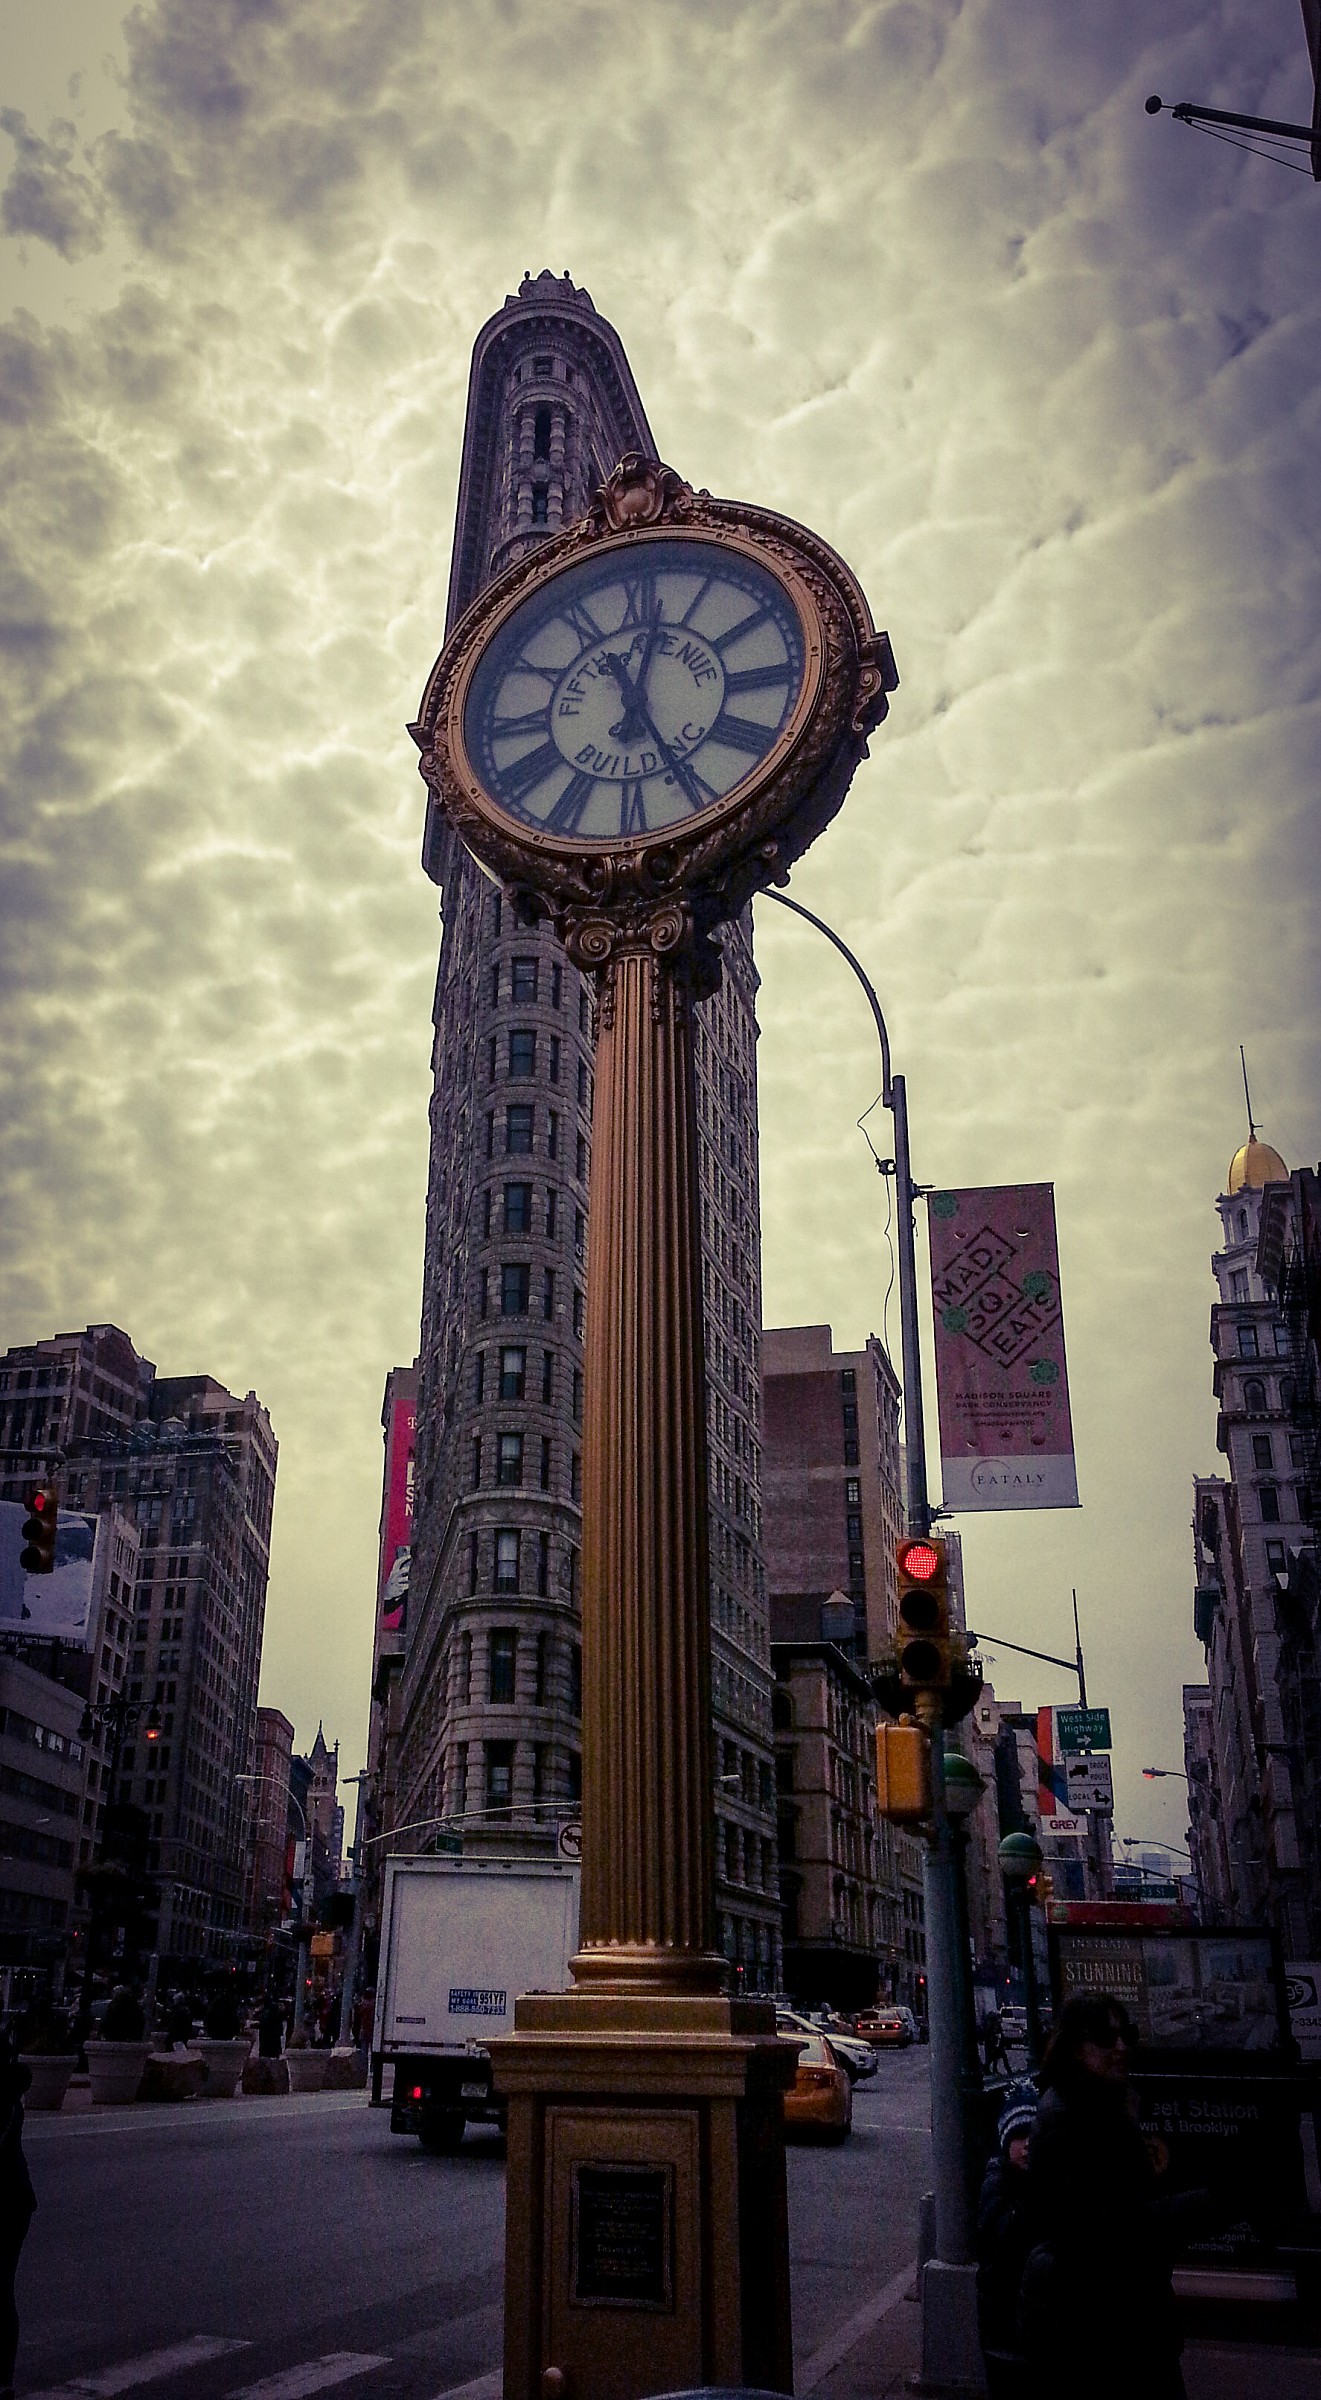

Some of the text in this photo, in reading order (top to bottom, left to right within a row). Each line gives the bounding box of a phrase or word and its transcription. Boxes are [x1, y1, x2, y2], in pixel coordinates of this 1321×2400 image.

[934, 1247, 1002, 1306] MAD.
[991, 1291, 1057, 1355] EATS
[955, 1390, 1052, 1400] MADISON SQUARE
[982, 1400, 1052, 1408] CONSERVANCY
[977, 1474, 1045, 1485] EATALY
[1060, 1712, 1106, 1723] West Side
[1064, 1723, 1104, 1735] Highway
[1069, 1792, 1091, 1801] LOCAL
[1049, 1820, 1078, 1830] GREY
[1066, 1962, 1143, 1982] STUNNING
[450, 1990, 471, 1998] SAFETY
[480, 1993, 504, 2005] 951YF
[1188, 2099, 1260, 2119] Station
[1179, 2120, 1239, 2136] Brooklyn
